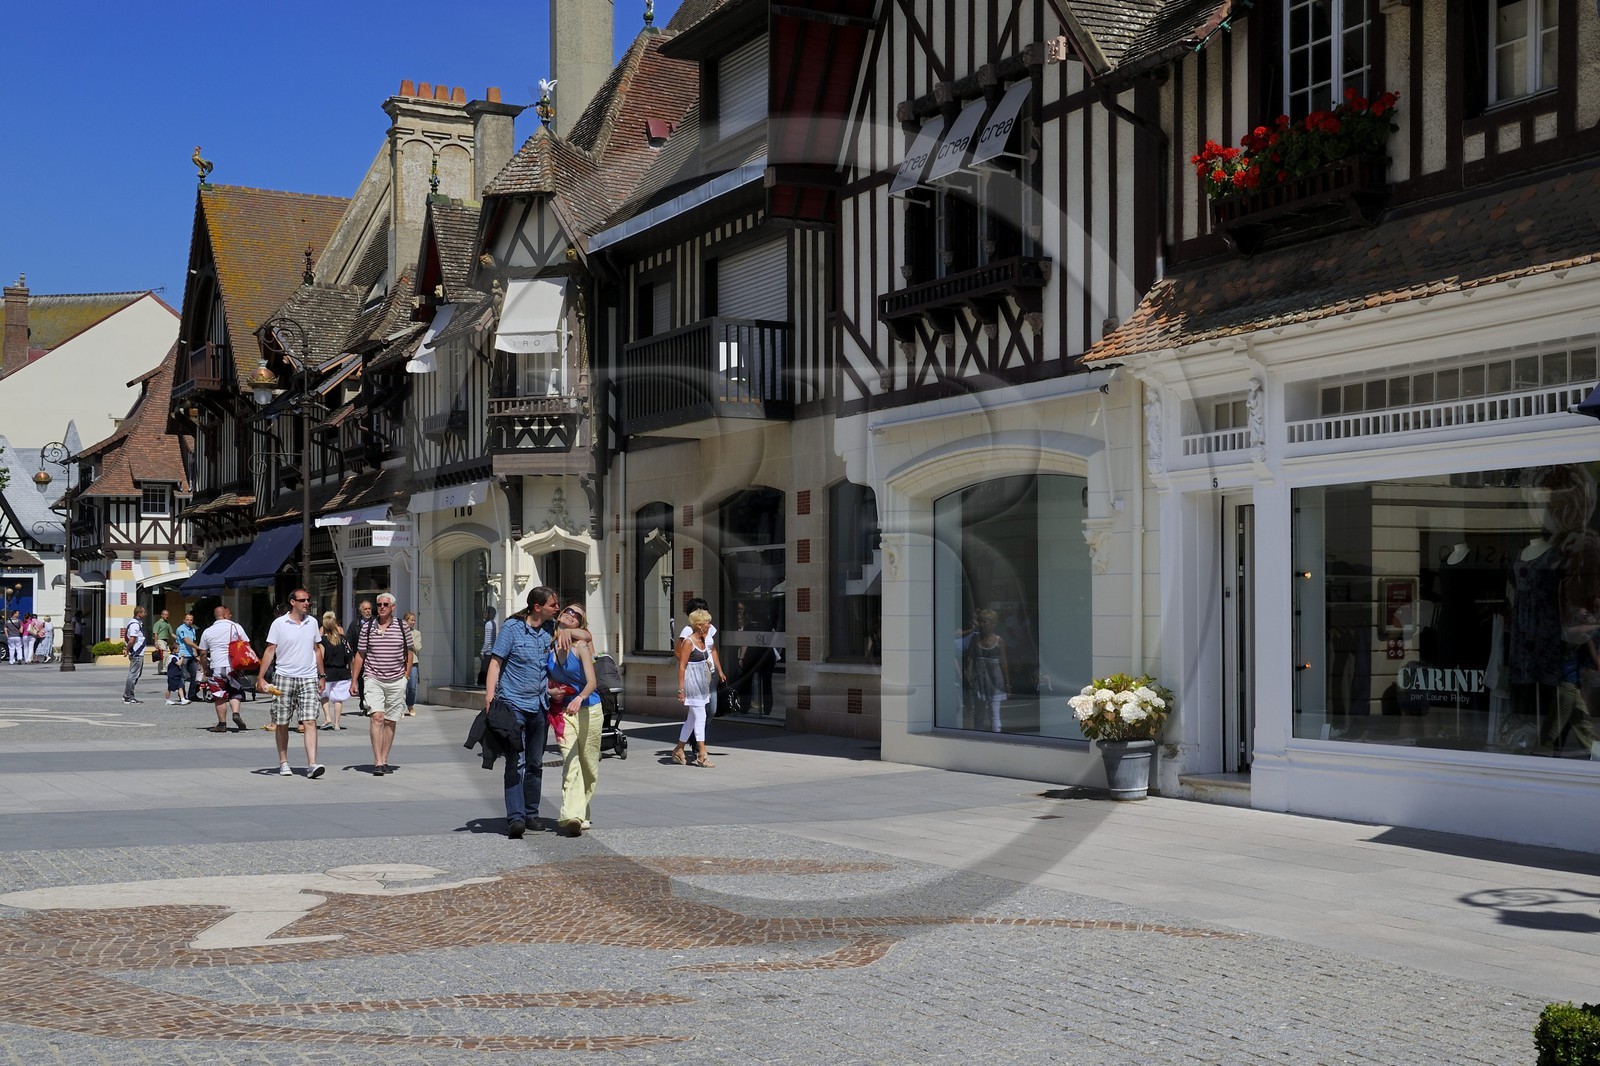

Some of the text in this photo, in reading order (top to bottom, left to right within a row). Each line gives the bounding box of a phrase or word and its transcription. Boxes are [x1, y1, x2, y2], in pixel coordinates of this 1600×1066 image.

[980, 117, 1014, 143] crea
[937, 136, 970, 160] crea
[898, 153, 928, 175] crea
[1212, 477, 1219, 488] 5
[454, 505, 472, 518] IRO
[1397, 667, 1485, 693] CARINE
[1410, 693, 1424, 701] par
[1426, 693, 1448, 702] Laure
